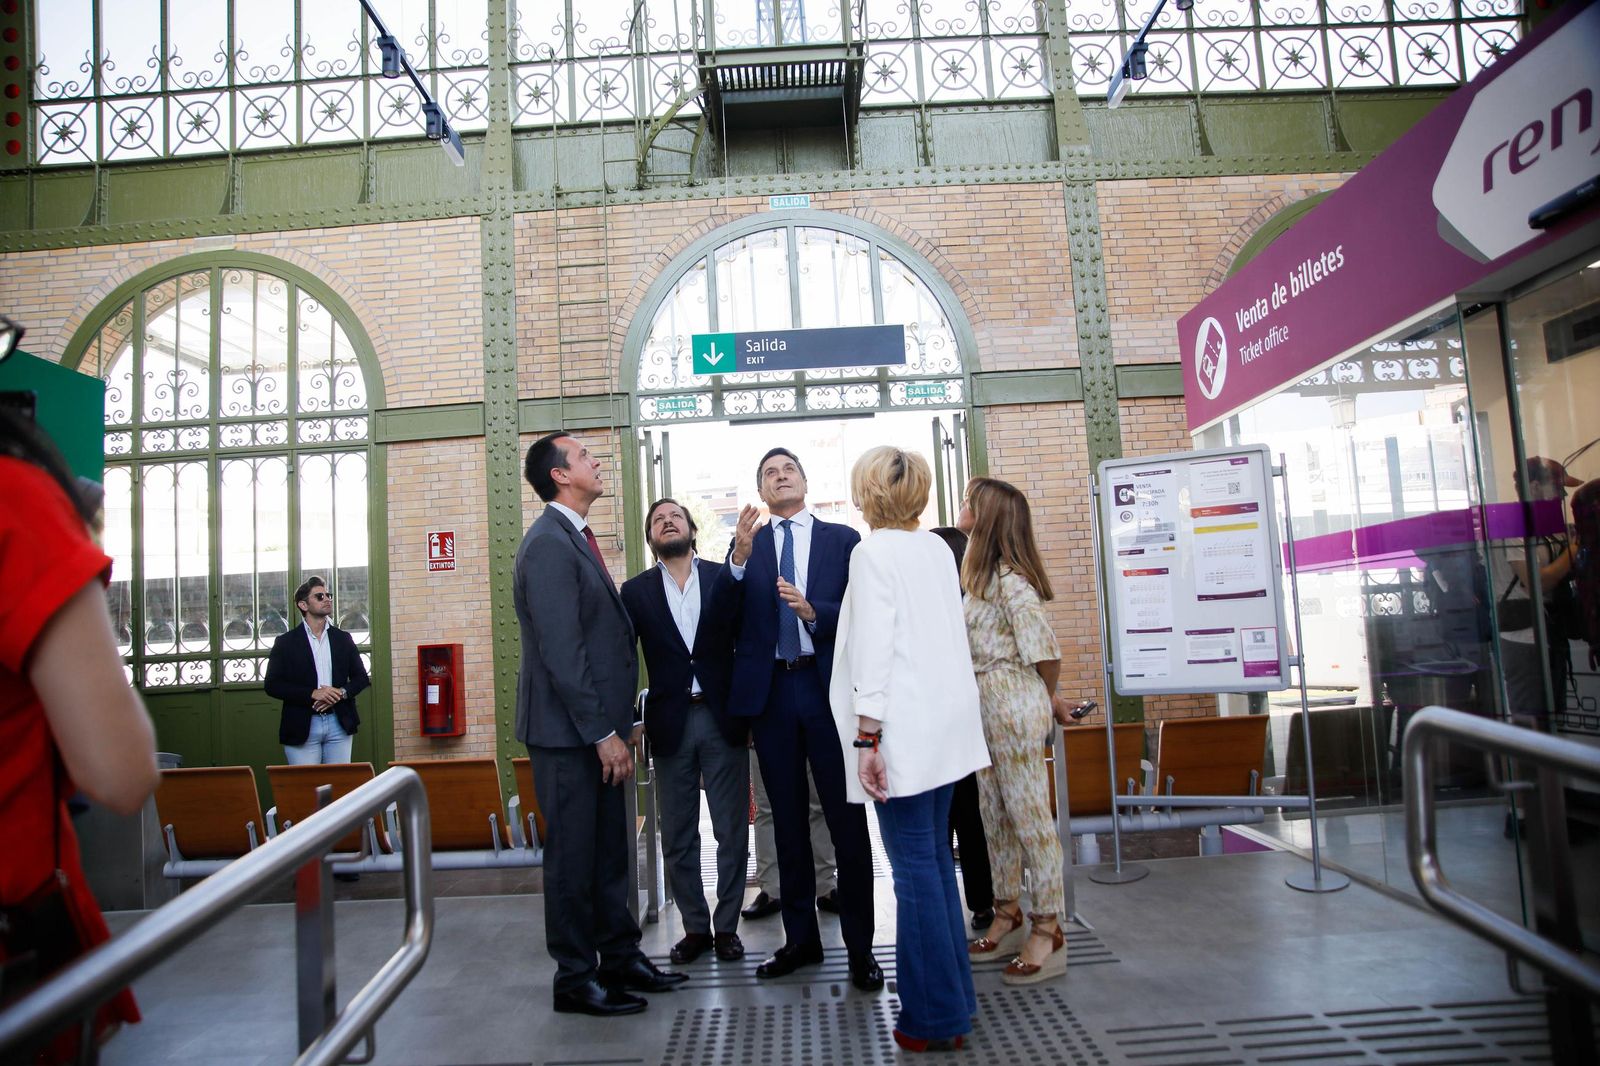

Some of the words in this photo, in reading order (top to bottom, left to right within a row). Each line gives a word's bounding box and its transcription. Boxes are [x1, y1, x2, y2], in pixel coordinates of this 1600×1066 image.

[1483, 87, 1600, 194] ren
[773, 197, 806, 207] SALIDA
[1235, 298, 1269, 333] Venta
[1271, 282, 1288, 310] de
[1289, 245, 1345, 298] billetes
[745, 338, 787, 352] Salida
[1238, 338, 1263, 366] Ticket
[1264, 325, 1289, 351] office
[746, 356, 765, 365] EXIT
[908, 387, 944, 395] SALIDA
[659, 401, 695, 410] SALIDA
[429, 561, 455, 570] EXTINTOR
